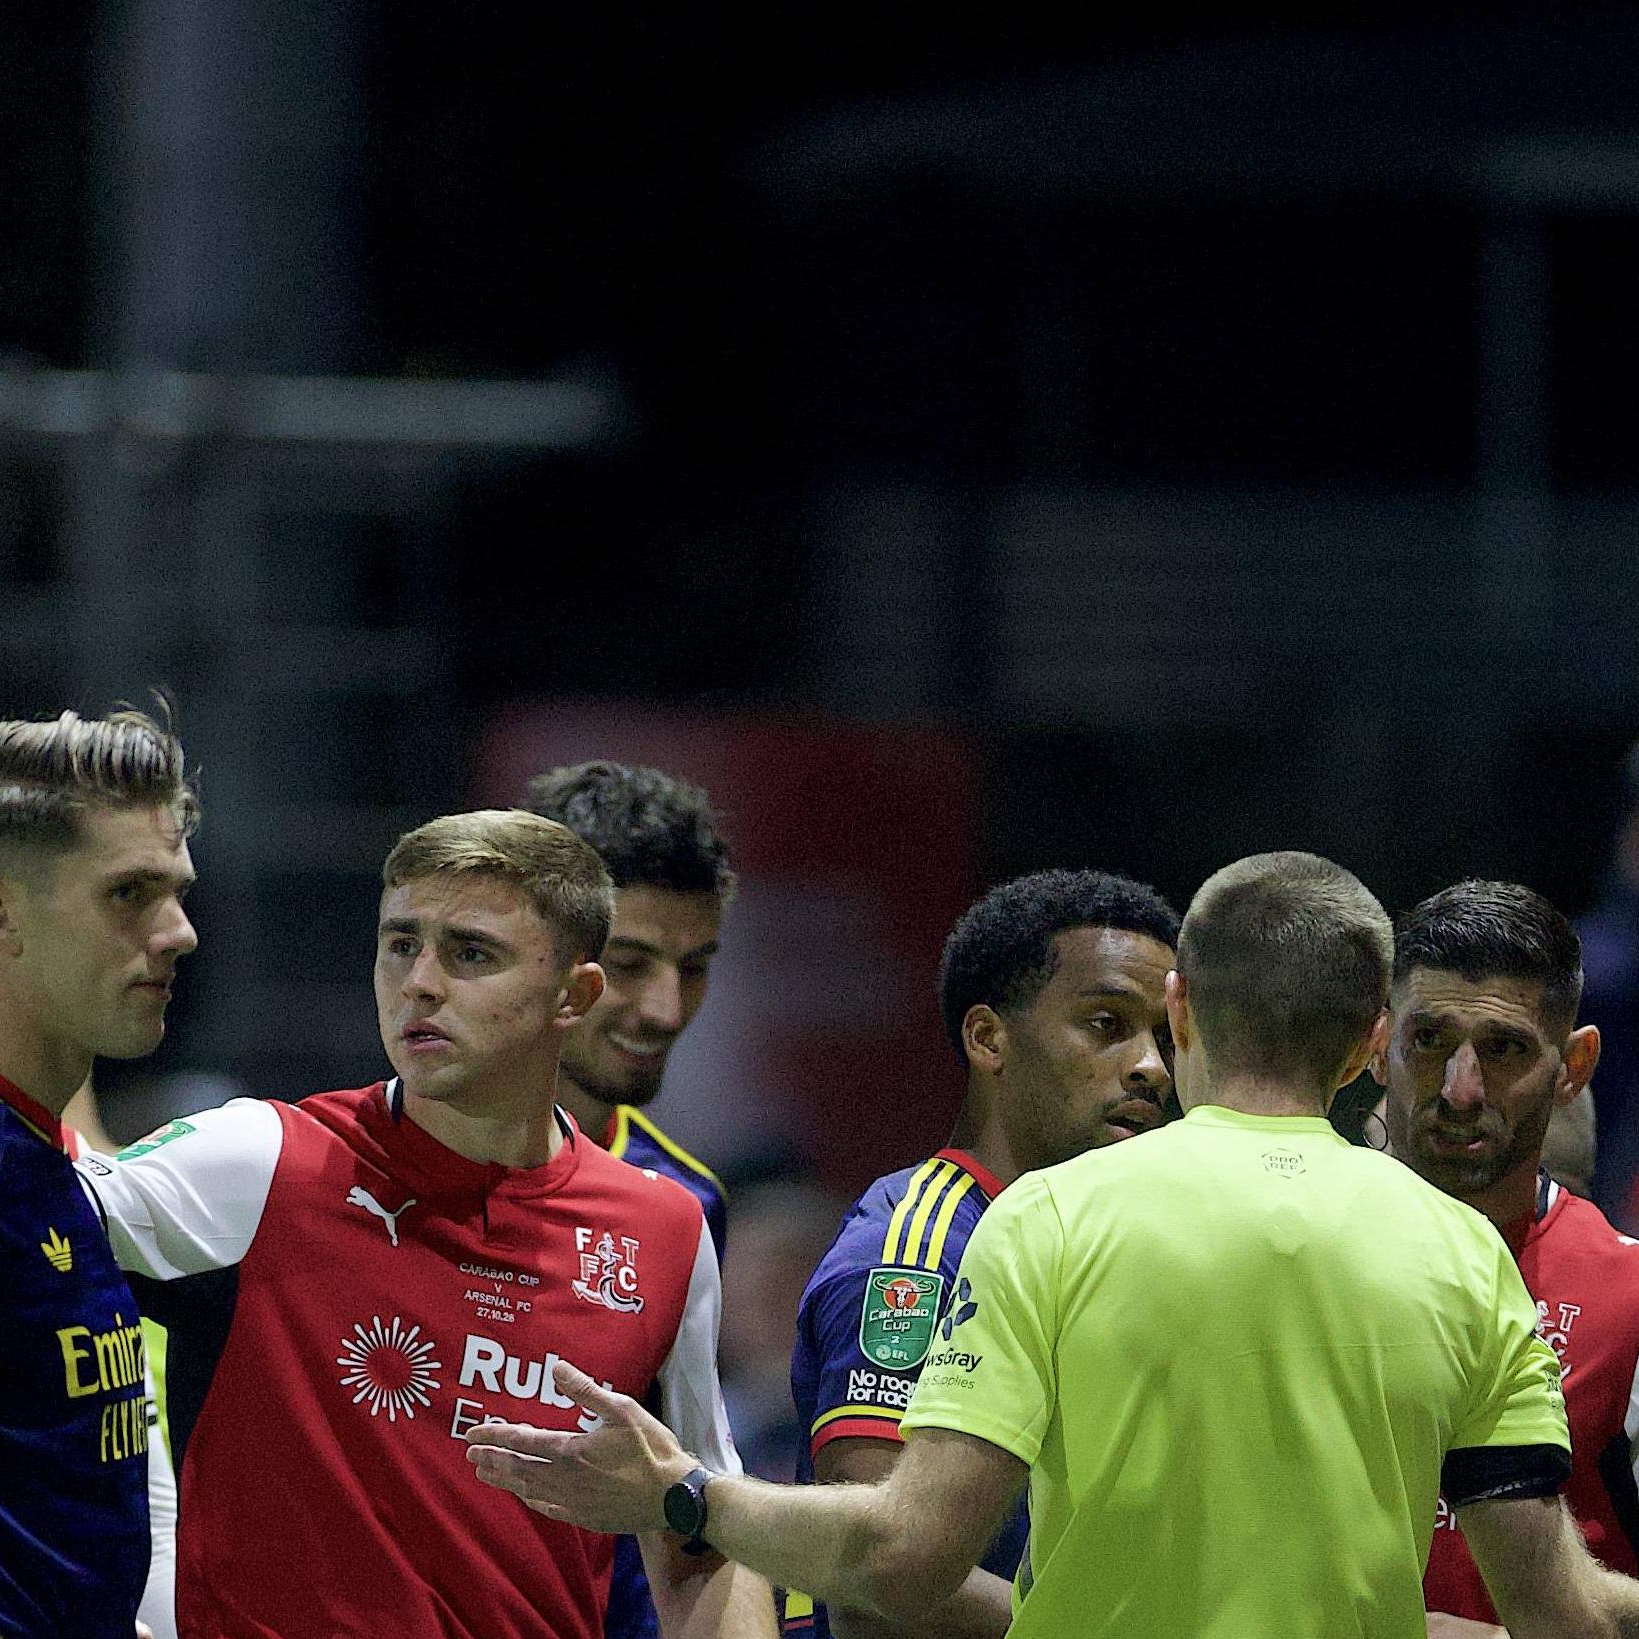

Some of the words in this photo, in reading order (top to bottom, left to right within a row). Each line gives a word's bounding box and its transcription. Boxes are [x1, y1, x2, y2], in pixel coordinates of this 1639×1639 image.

[459, 1262, 514, 1282] CARABAO
[518, 1274, 540, 1287] CUP
[463, 1289, 513, 1309] ARSENAL
[516, 1300, 532, 1313] FC
[869, 1305, 930, 1323] Carabao
[882, 1320, 912, 1333] Cup
[890, 1335, 901, 1344] 2
[892, 1349, 910, 1362] EFL
[848, 1368, 878, 1389] No
[846, 1382, 875, 1402] for
